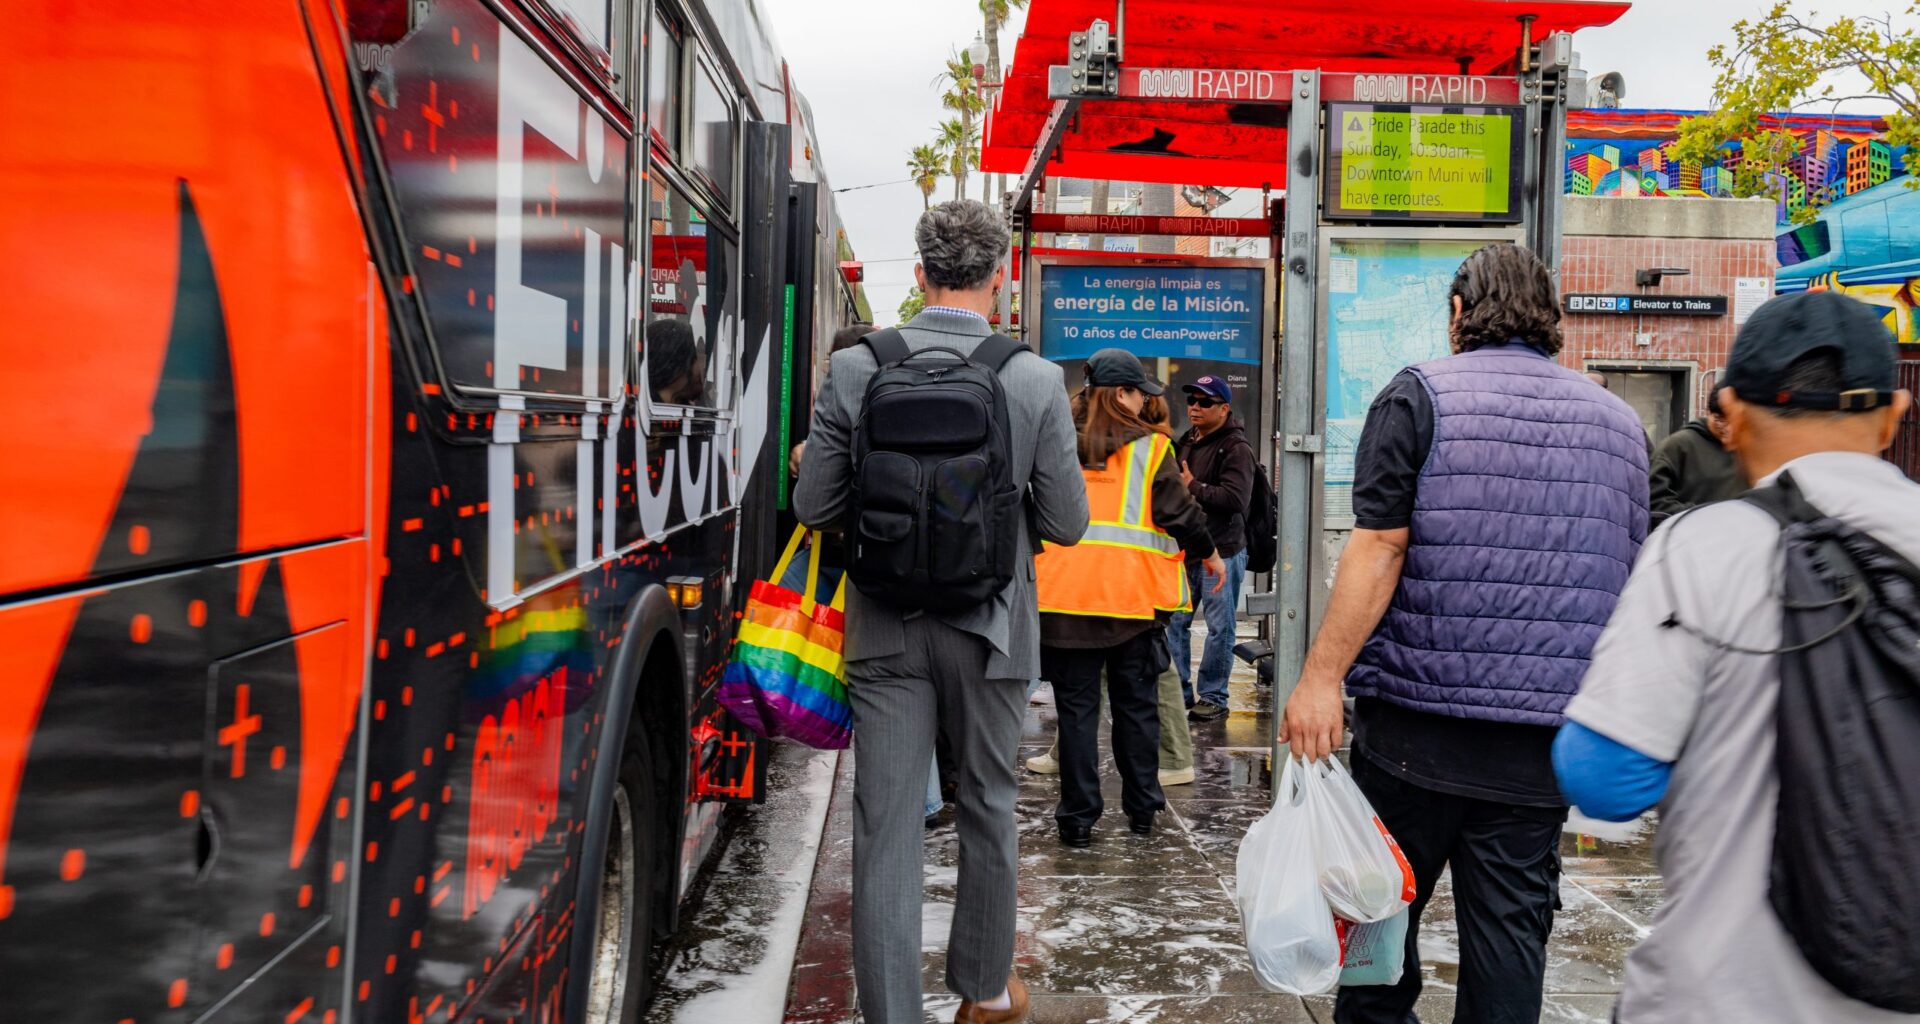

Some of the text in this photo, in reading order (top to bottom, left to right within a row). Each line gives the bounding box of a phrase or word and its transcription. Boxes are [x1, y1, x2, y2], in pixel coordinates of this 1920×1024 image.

[1198, 70, 1273, 99] RAPID
[1410, 76, 1487, 104] RAPID
[1369, 117, 1485, 135] Pride Parade this
[1347, 141, 1401, 159] Sunday,
[1347, 165, 1492, 183] Downtown Muni will
[1346, 187, 1443, 206] have reroutes.
[1100, 216, 1145, 233] RAPID
[1194, 218, 1239, 236] RAPID
[1084, 276, 1221, 291] La energía limpia es
[1054, 294, 1250, 313] energía de la Misión.
[1633, 299, 1711, 310] Elevator to Trains
[1063, 326, 1240, 341] 10 años de CleanPowerSF
[1227, 374, 1247, 382] Diana
